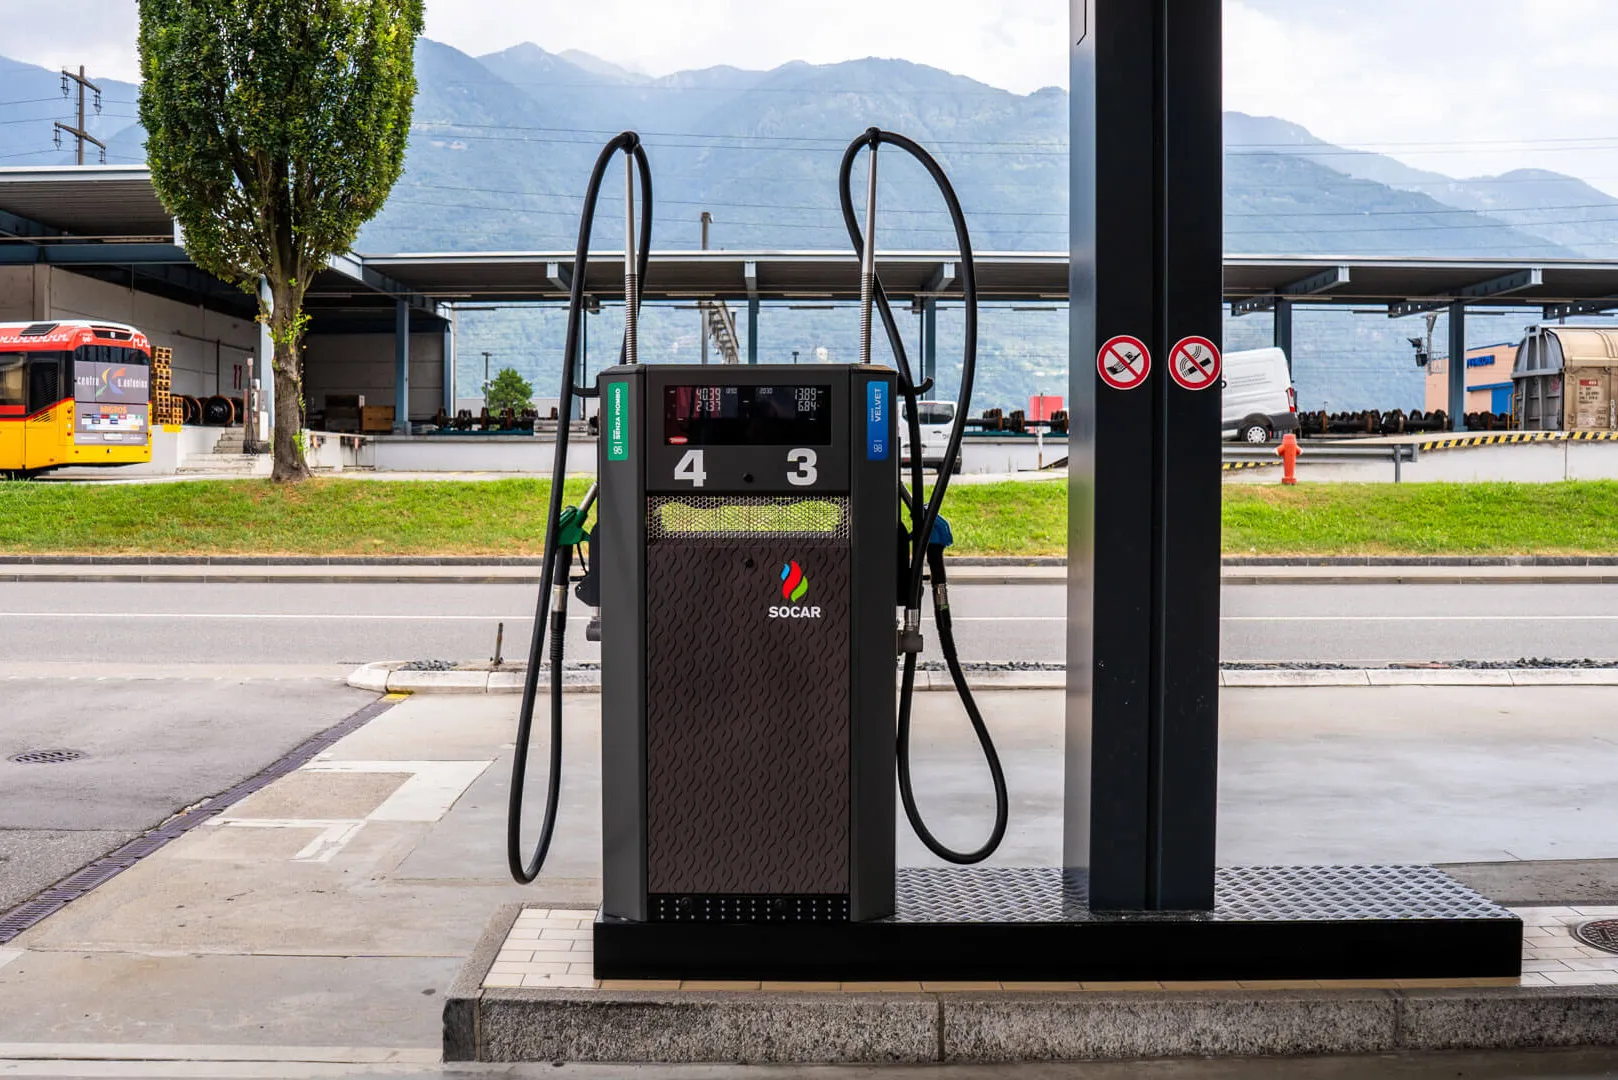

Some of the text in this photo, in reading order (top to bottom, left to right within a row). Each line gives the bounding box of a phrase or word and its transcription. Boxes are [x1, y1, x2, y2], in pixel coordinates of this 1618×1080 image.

[77, 375, 99, 386] centro
[874, 388, 882, 422] VELVET
[674, 449, 707, 487] 4
[786, 447, 818, 486] 3
[768, 606, 821, 618] SOCAR
